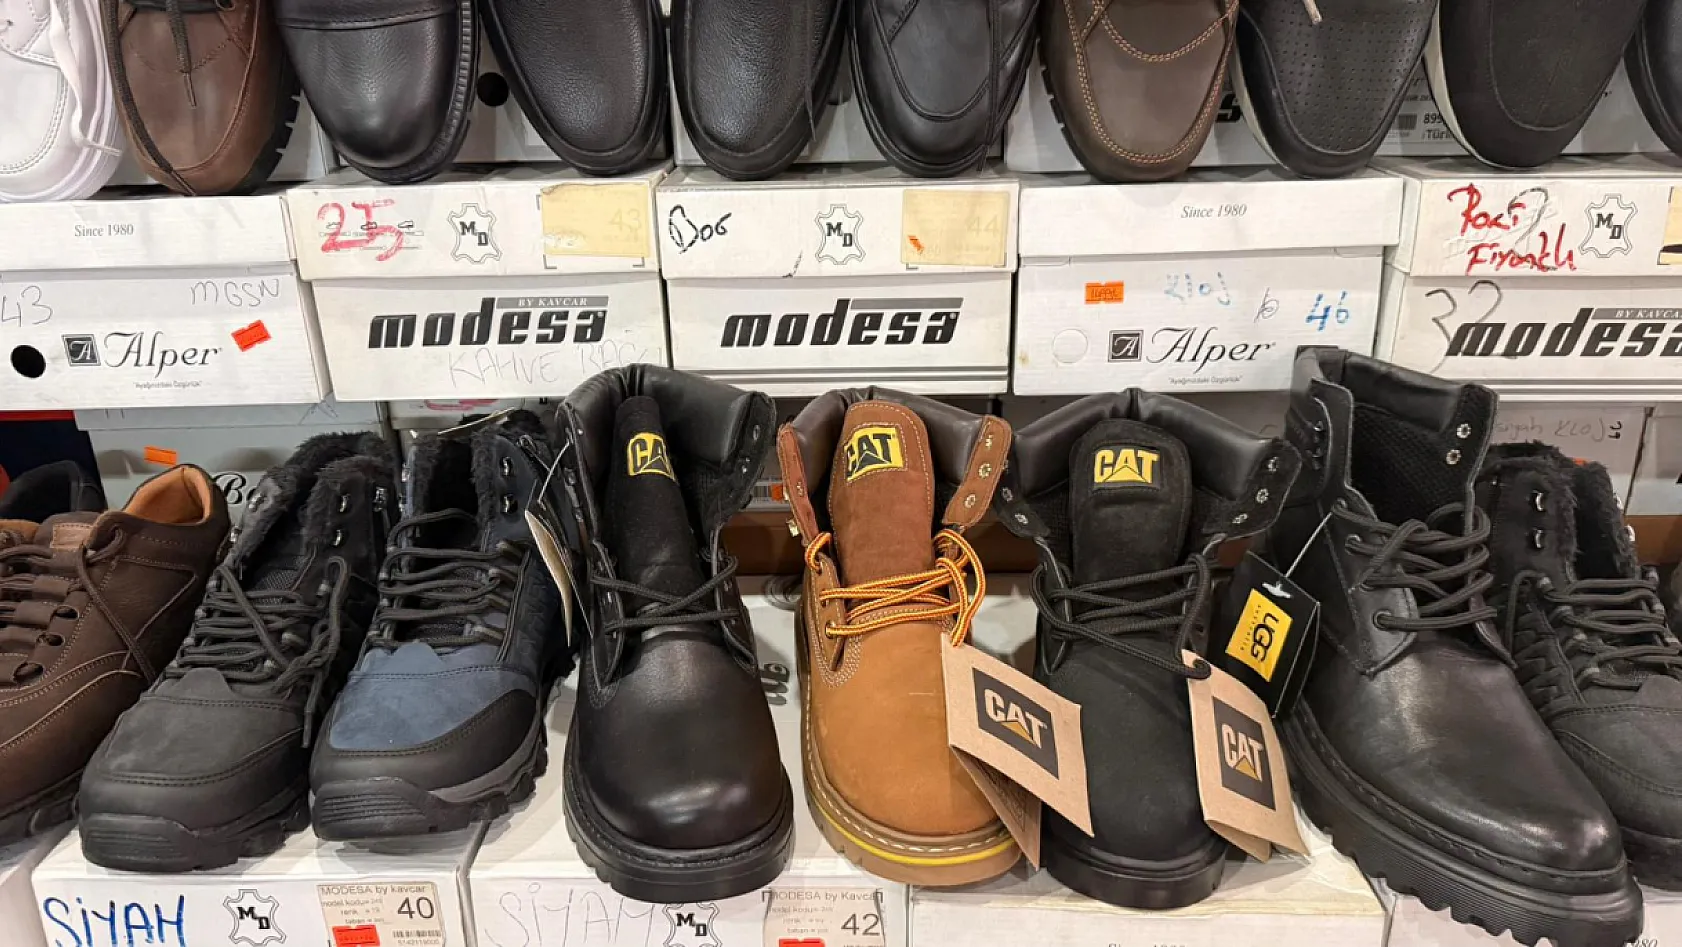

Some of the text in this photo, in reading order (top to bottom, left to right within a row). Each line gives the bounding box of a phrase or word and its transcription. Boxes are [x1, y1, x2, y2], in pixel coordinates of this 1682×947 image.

[1181, 204, 1248, 218] Since 1980
[74, 224, 134, 237] Since 1980
[317, 199, 405, 262] 25
[1, 285, 53, 327] 43
[518, 297, 588, 307] BY KAVCAR
[1305, 290, 1350, 332] 46
[1615, 309, 1682, 318] BY KAVCA
[368, 297, 608, 349] modesa
[720, 298, 961, 348] modesa
[104, 331, 219, 378] Alper
[1146, 326, 1272, 374] Alper
[632, 438, 670, 474] CA
[1094, 449, 1159, 484] CAT
[984, 688, 1047, 750] CAT
[1221, 723, 1265, 783] CAT
[321, 885, 373, 896] MODESA
[375, 884, 388, 895] by
[397, 896, 435, 919] 40
[825, 891, 838, 902] by
[840, 913, 881, 936] 42
